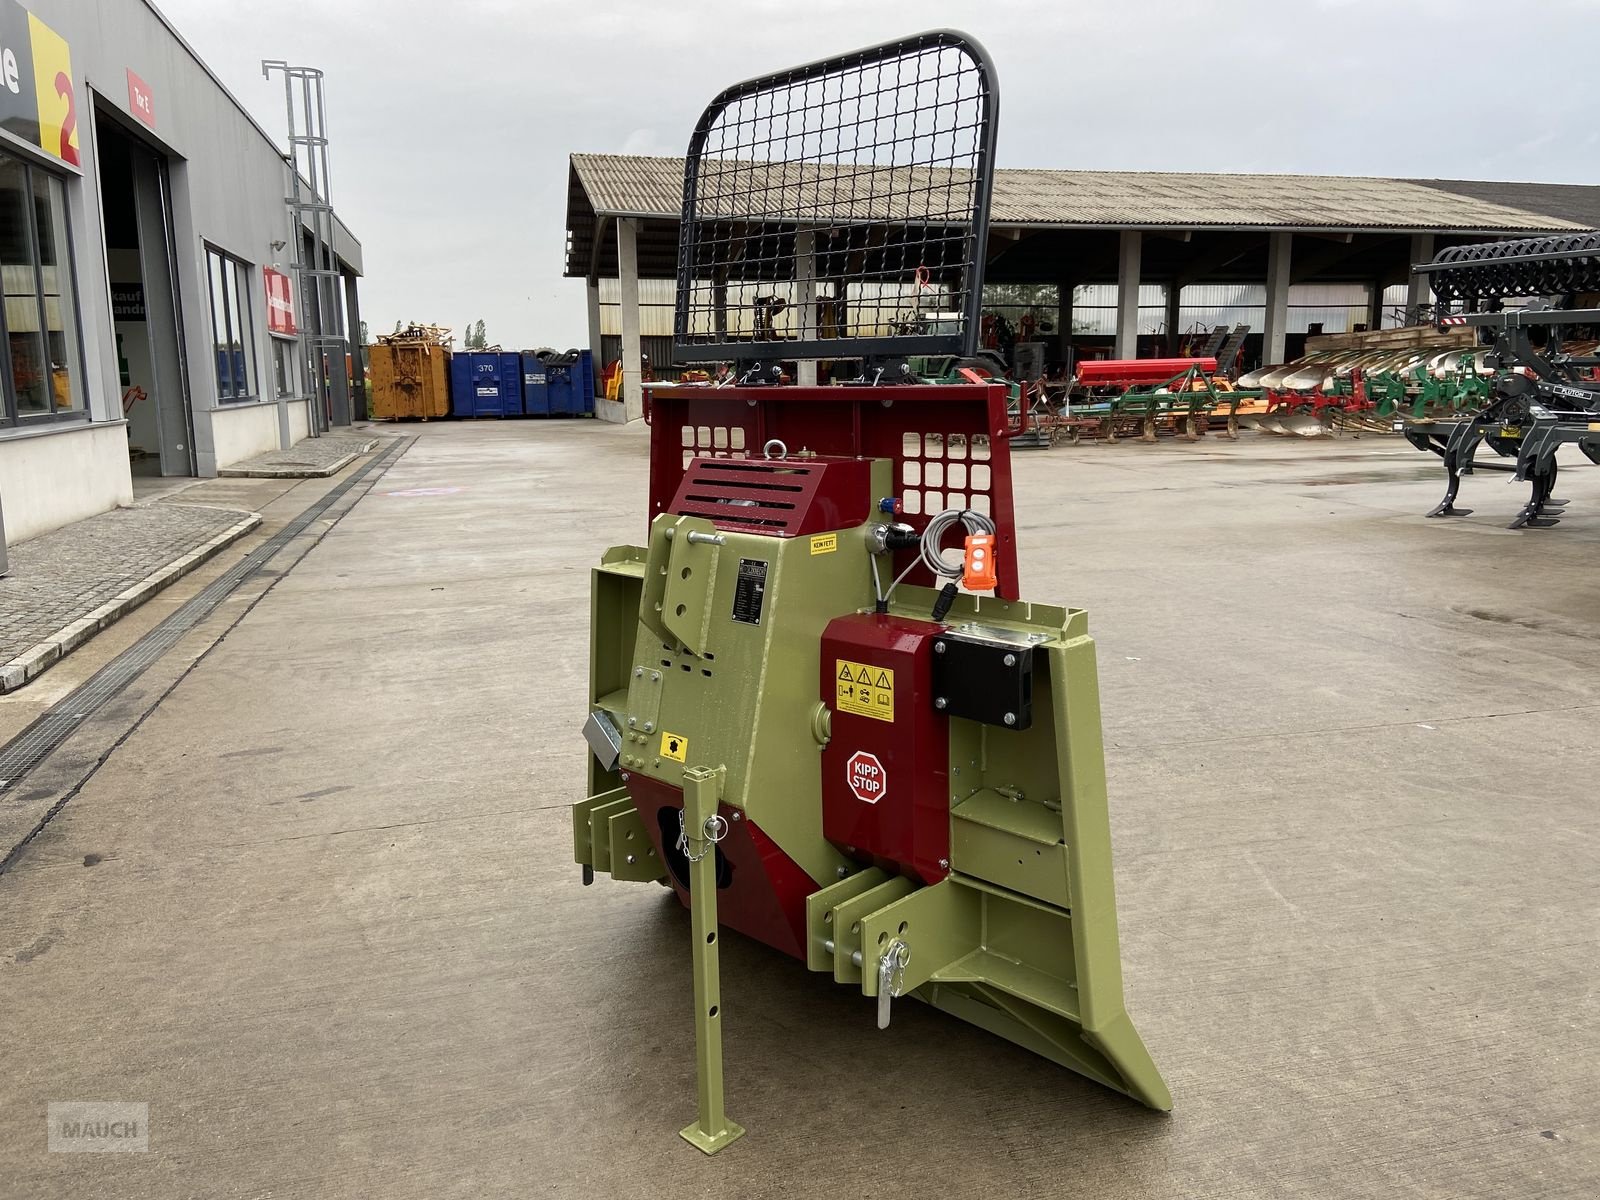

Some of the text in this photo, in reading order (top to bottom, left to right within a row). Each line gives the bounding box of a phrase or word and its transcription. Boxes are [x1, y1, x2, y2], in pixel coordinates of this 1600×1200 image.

[134, 86, 150, 113] Tor E
[479, 364, 494, 372] 370
[855, 761, 879, 778] KIPP
[853, 775, 880, 793] STOP
